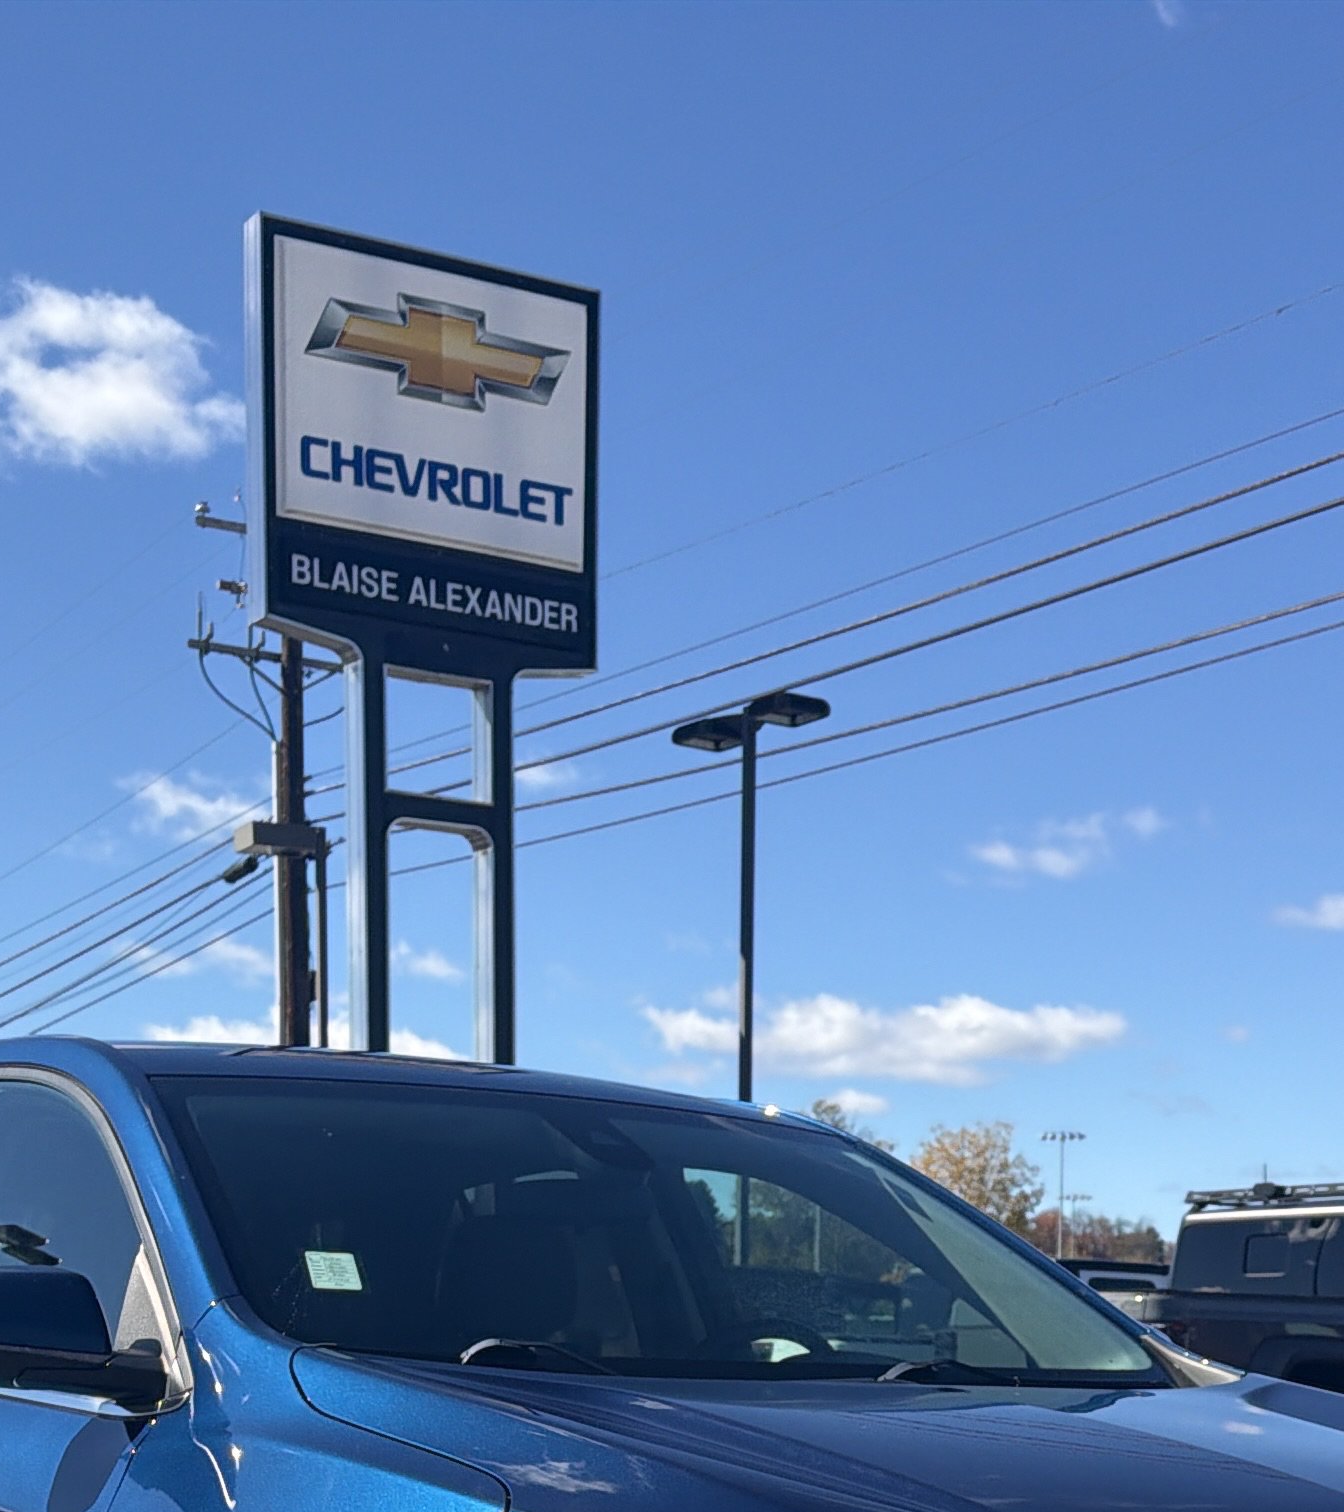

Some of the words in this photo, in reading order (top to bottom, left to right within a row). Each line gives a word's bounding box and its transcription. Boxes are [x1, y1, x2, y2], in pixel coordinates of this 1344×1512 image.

[300, 435, 573, 526] CHEVROLET
[291, 553, 399, 602] BLAISE
[408, 576, 578, 633] ALEXANDER
